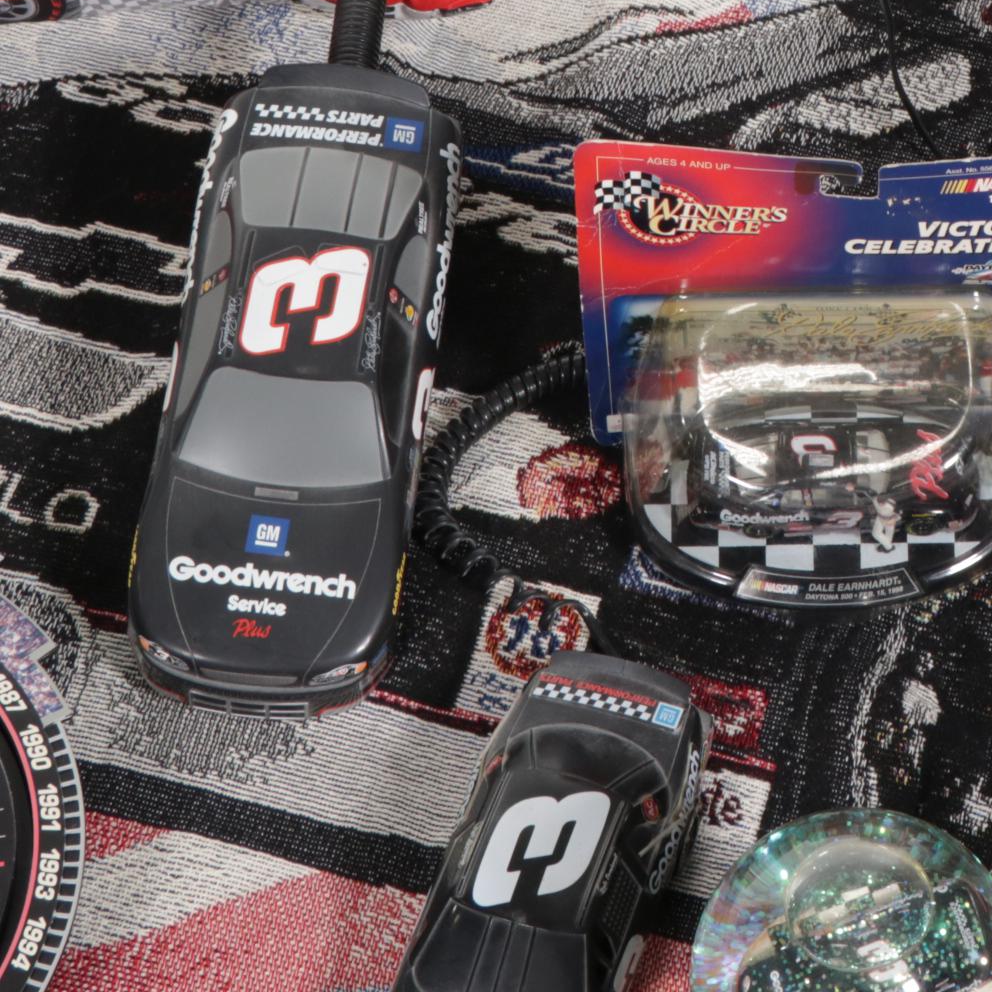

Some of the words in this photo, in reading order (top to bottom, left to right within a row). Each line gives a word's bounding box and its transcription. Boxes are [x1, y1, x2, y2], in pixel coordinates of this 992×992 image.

[326, 109, 386, 128] PARTS
[249, 122, 381, 147] PERFORMANCE
[392, 124, 417, 146] GM
[646, 157, 678, 166] AGES
[689, 160, 714, 170] AND
[715, 162, 732, 171] UP
[633, 195, 788, 223] WINNER'S
[649, 213, 761, 236] CIRCLE
[239, 245, 371, 356] 3
[720, 508, 810, 526] Goodwrench
[254, 523, 282, 543] GM
[168, 555, 358, 600] Goodwrench
[762, 582, 799, 595] NASCAR
[808, 581, 836, 592] DALE
[836, 577, 900, 591] EARNHARDT
[227, 594, 287, 617] Service
[804, 592, 839, 601] DAYTONA
[231, 617, 273, 640] Plus
[19, 723, 52, 771] 1990
[37, 783, 62, 831] 1991
[472, 791, 611, 908] 3
[34, 847, 61, 901] 1993
[11, 916, 47, 972] 1994
